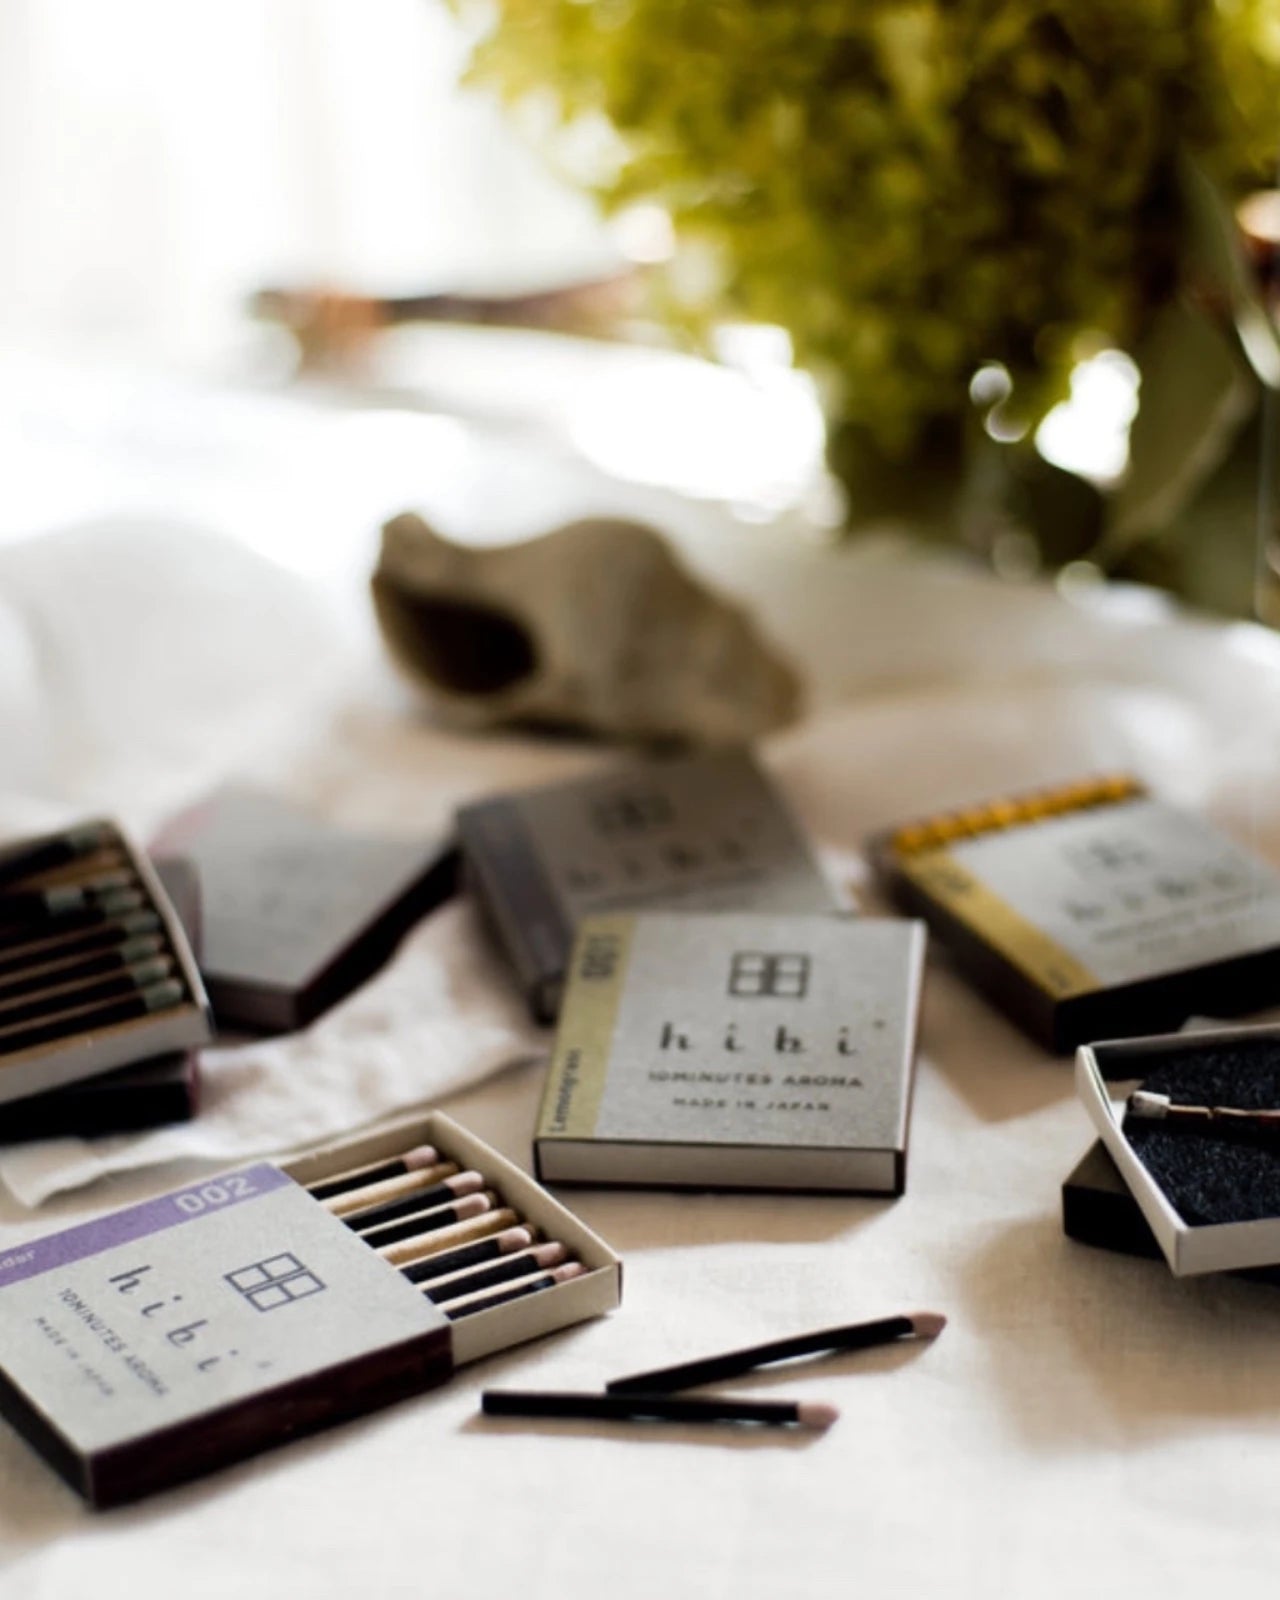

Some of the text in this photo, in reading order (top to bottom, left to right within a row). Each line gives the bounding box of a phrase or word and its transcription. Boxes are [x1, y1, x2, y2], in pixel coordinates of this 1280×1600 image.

[648, 1070, 864, 1089] 10MINUTES AROMA
[673, 1097, 728, 1109] MADE
[765, 1101, 831, 1112] JAPAN
[175, 1177, 259, 1213] 002
[57, 1287, 128, 1353] 10MINUTES
[108, 1264, 240, 1373] hibi
